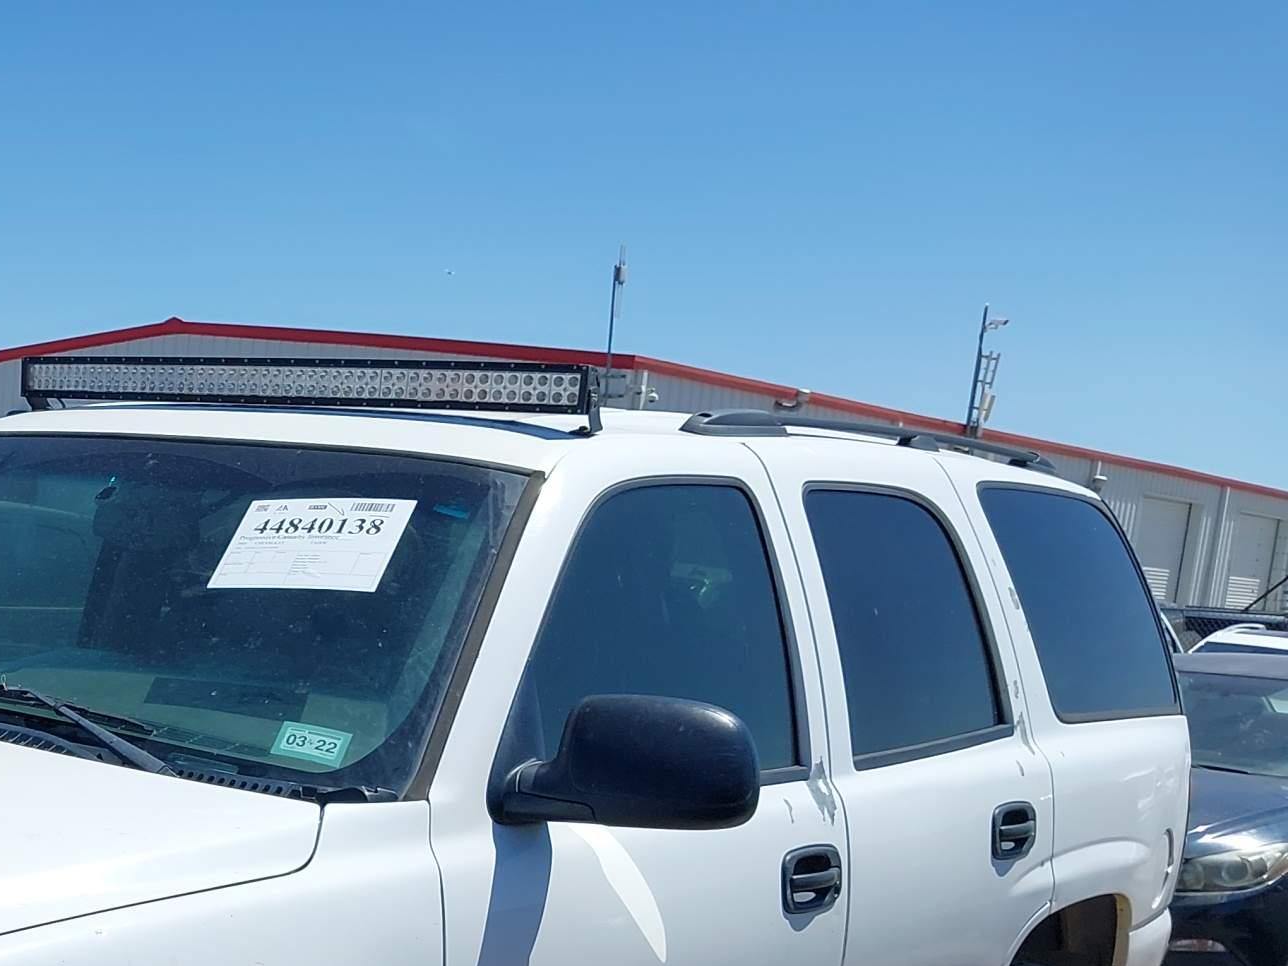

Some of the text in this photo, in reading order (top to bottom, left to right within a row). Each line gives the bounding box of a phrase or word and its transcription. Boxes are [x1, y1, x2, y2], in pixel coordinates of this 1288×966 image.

[253, 517, 385, 535] 44840138
[286, 733, 308, 747] 03
[314, 739, 338, 754] 22
